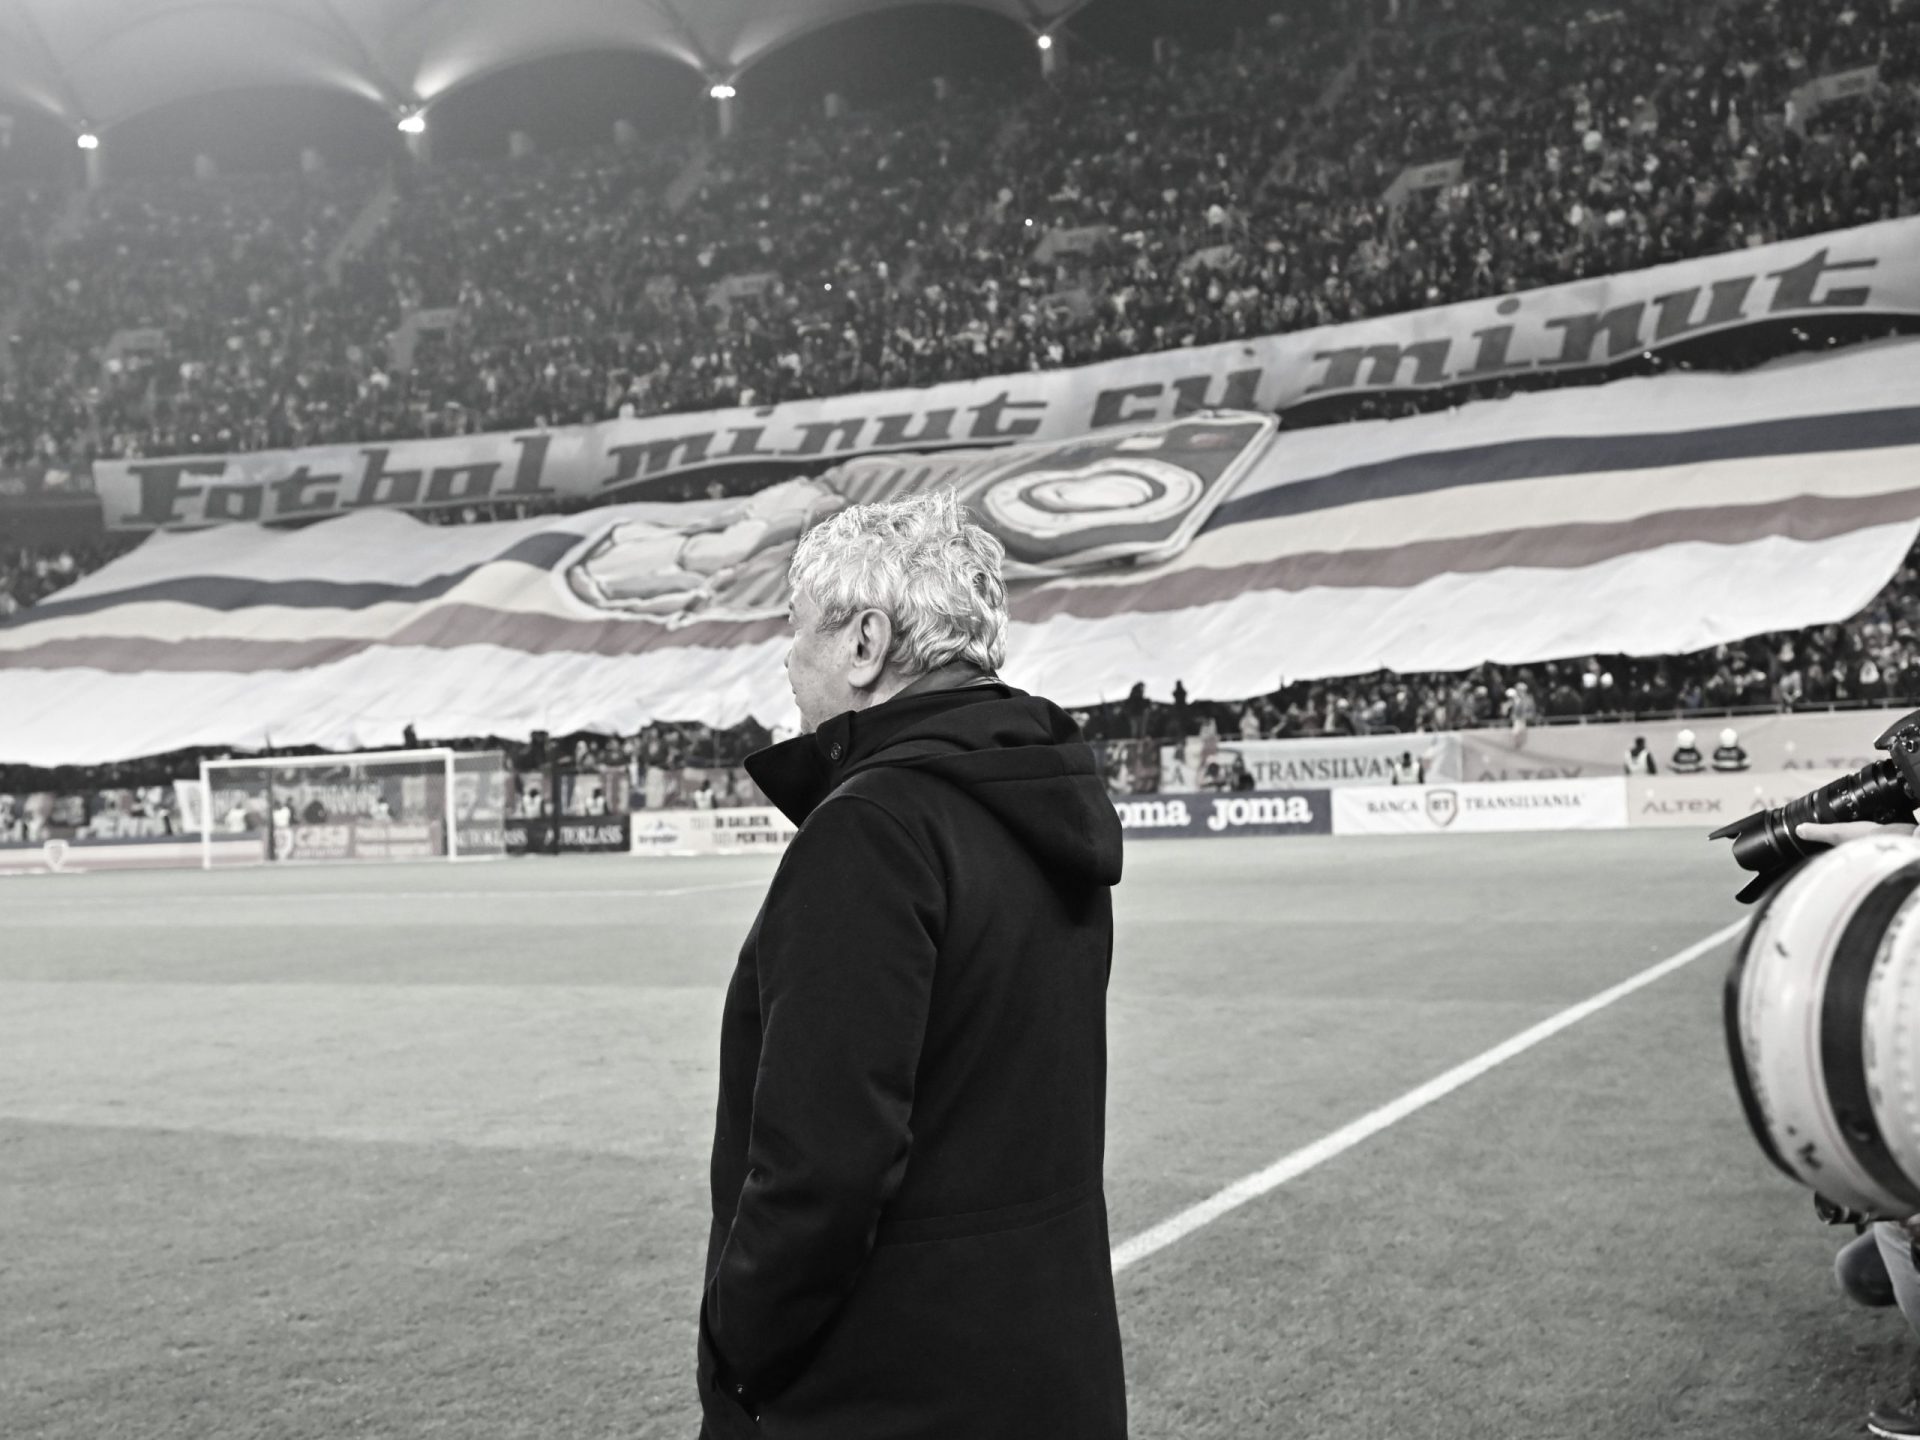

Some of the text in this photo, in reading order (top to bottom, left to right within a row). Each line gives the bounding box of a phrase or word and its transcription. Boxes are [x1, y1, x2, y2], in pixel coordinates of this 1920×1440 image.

[119, 246, 1879, 523] Fotbal minut cu minut
[1254, 756, 1403, 782] TRANSILVAN
[1114, 799, 1191, 829] oma
[1465, 793, 1582, 811] TRANSILVANIA
